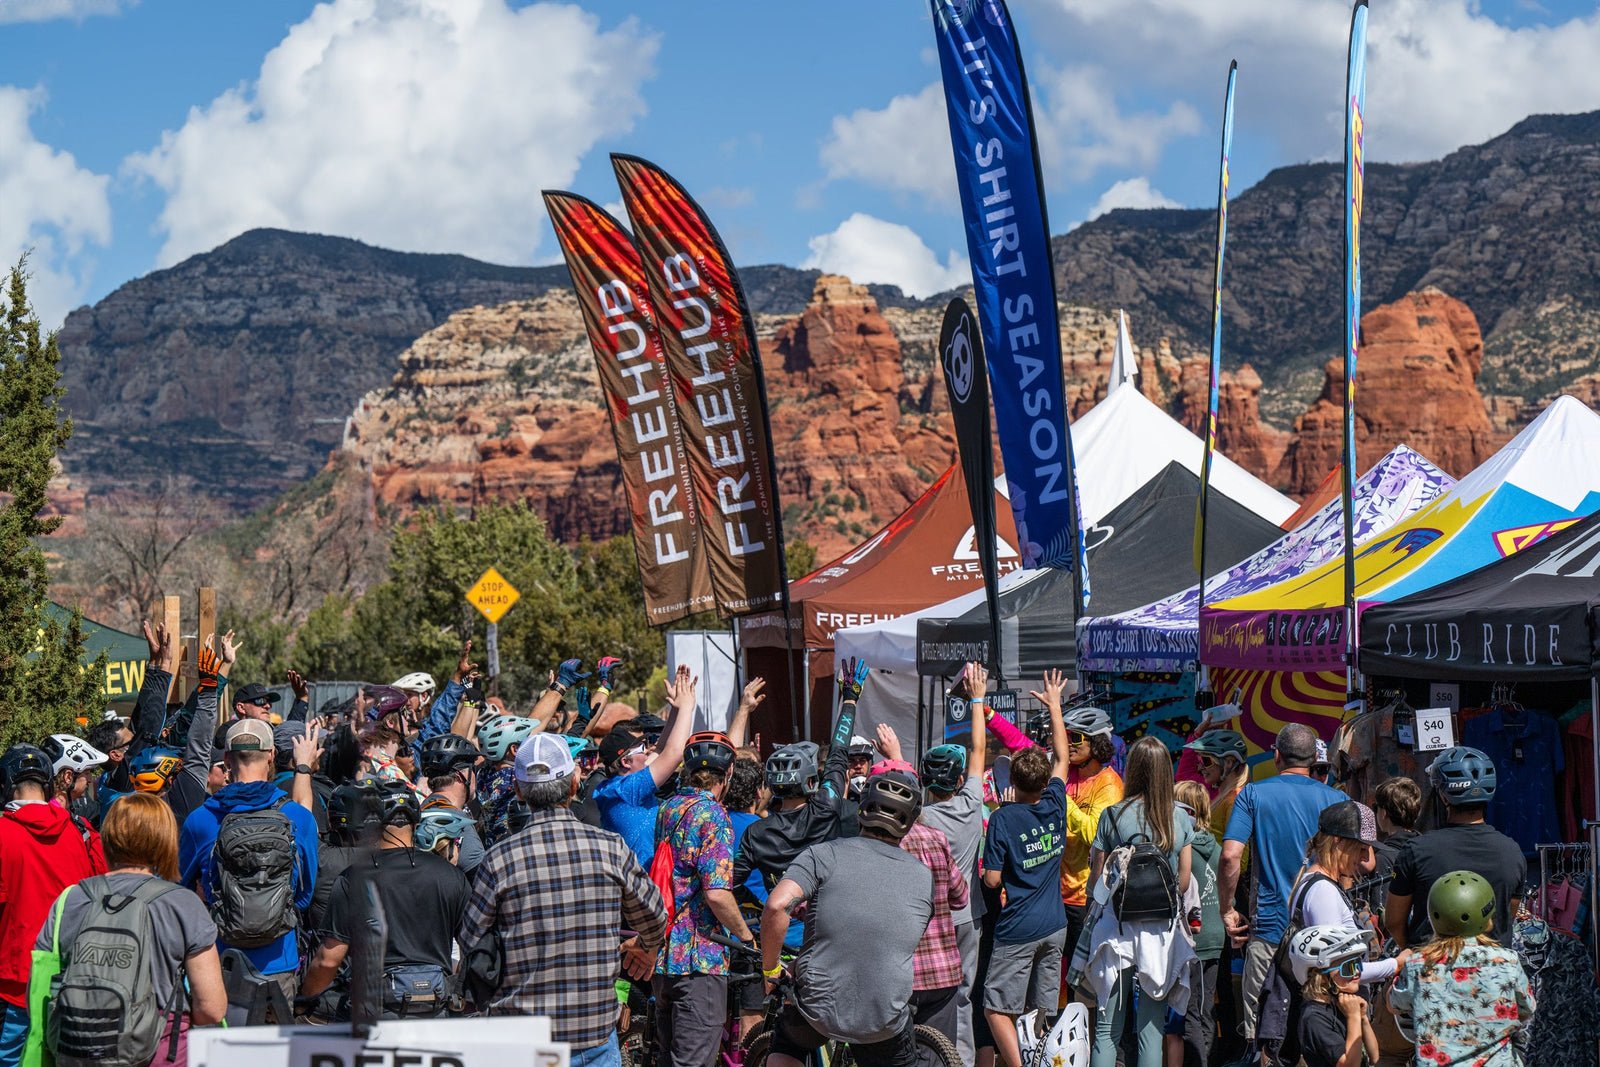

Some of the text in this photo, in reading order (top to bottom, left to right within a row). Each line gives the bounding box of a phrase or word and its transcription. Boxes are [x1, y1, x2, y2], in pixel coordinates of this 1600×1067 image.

[962, 36, 1068, 504] IT'S SHIRT SEASON
[717, 316, 730, 337] BIKE
[651, 335, 664, 359] BIKE
[724, 342, 745, 401] MOUNTAIN
[659, 362, 678, 416] MOUNTAIN
[663, 252, 765, 556] FREEHUB
[598, 279, 689, 565] FREEHUB
[740, 405, 755, 445] DRIVEN
[672, 421, 685, 459] DRIVEN
[679, 463, 697, 525] COMMUNITY
[751, 450, 769, 516] COMMUNITY
[481, 582, 504, 592] STOP
[946, 574, 970, 582] MTB
[478, 595, 509, 605] AHEAD
[1092, 630, 1114, 653] 100%
[1115, 629, 1140, 653] SHIRT
[1383, 622, 1564, 666] CLUB RIDE
[992, 694, 1016, 710] PANDA
[1436, 692, 1453, 703] $50
[835, 714, 852, 744] FOX
[1424, 720, 1444, 732] $40
[767, 771, 798, 783] FOX
[73, 942, 136, 970] VANS
